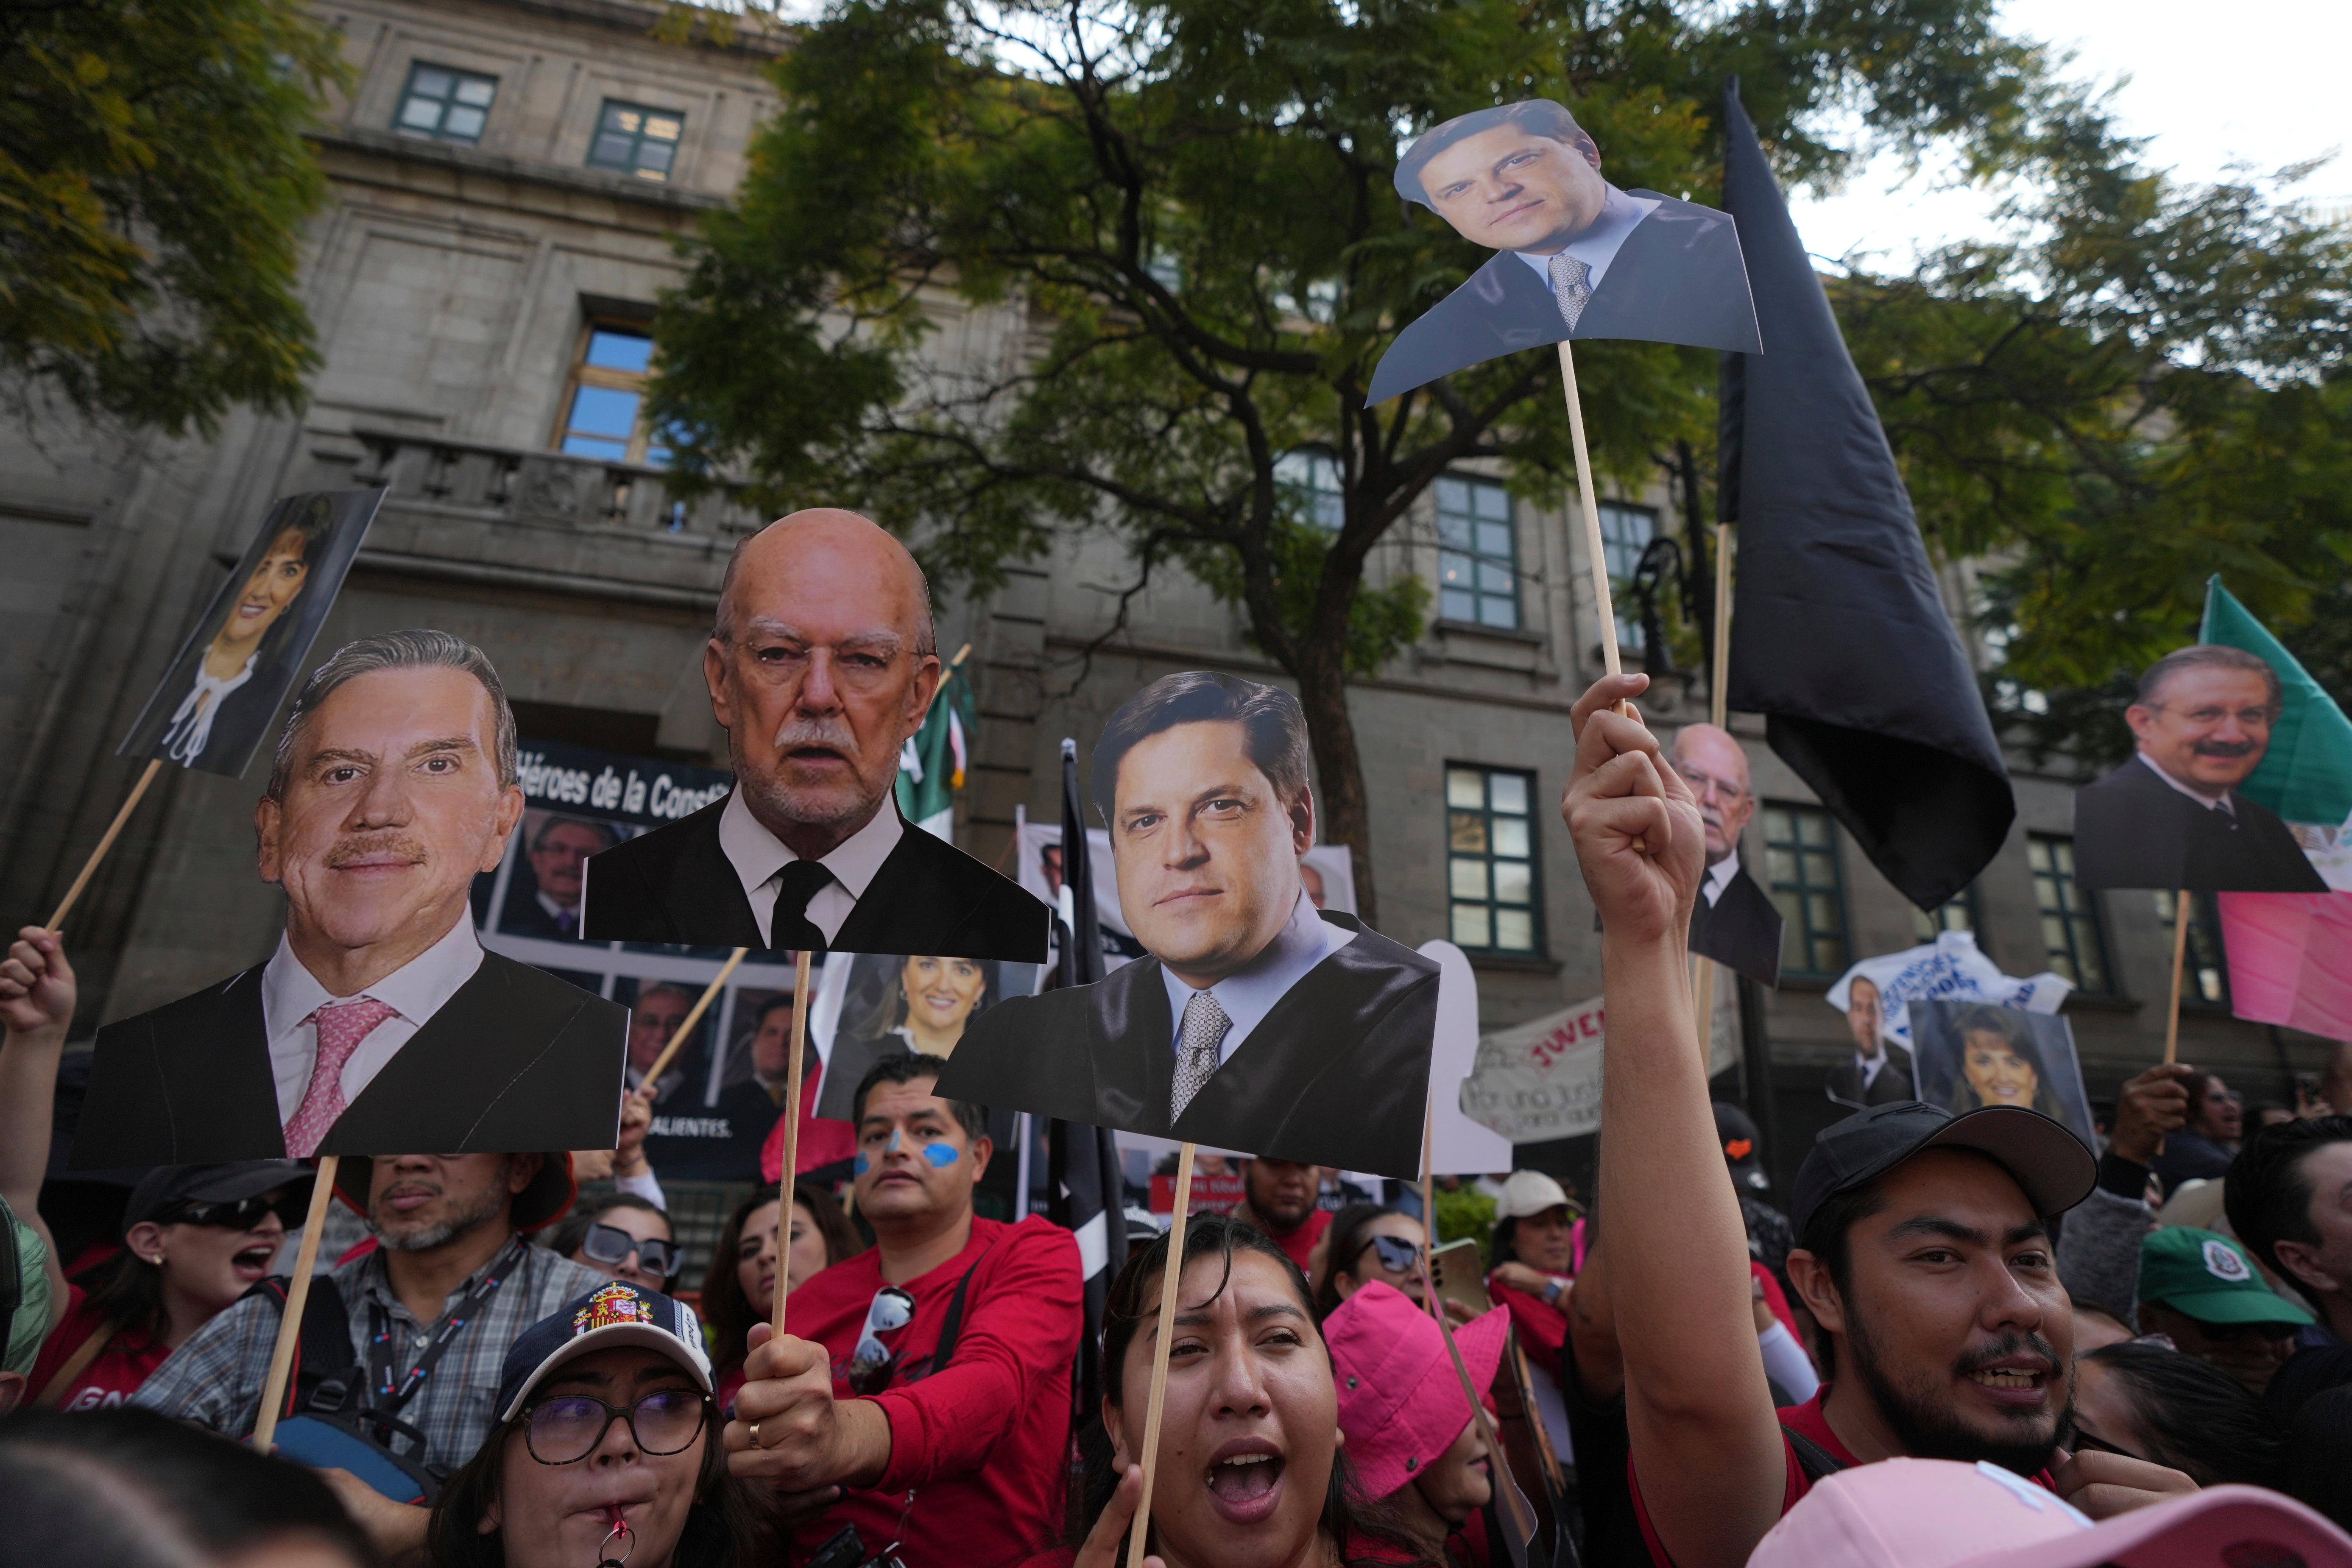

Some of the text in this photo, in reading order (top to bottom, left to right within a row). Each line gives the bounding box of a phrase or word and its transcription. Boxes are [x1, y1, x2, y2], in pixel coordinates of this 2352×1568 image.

[516, 751, 590, 804] Héroes
[591, 765, 622, 809] de
[622, 769, 647, 814] la
[647, 1116, 734, 1138] ALIENTES.
